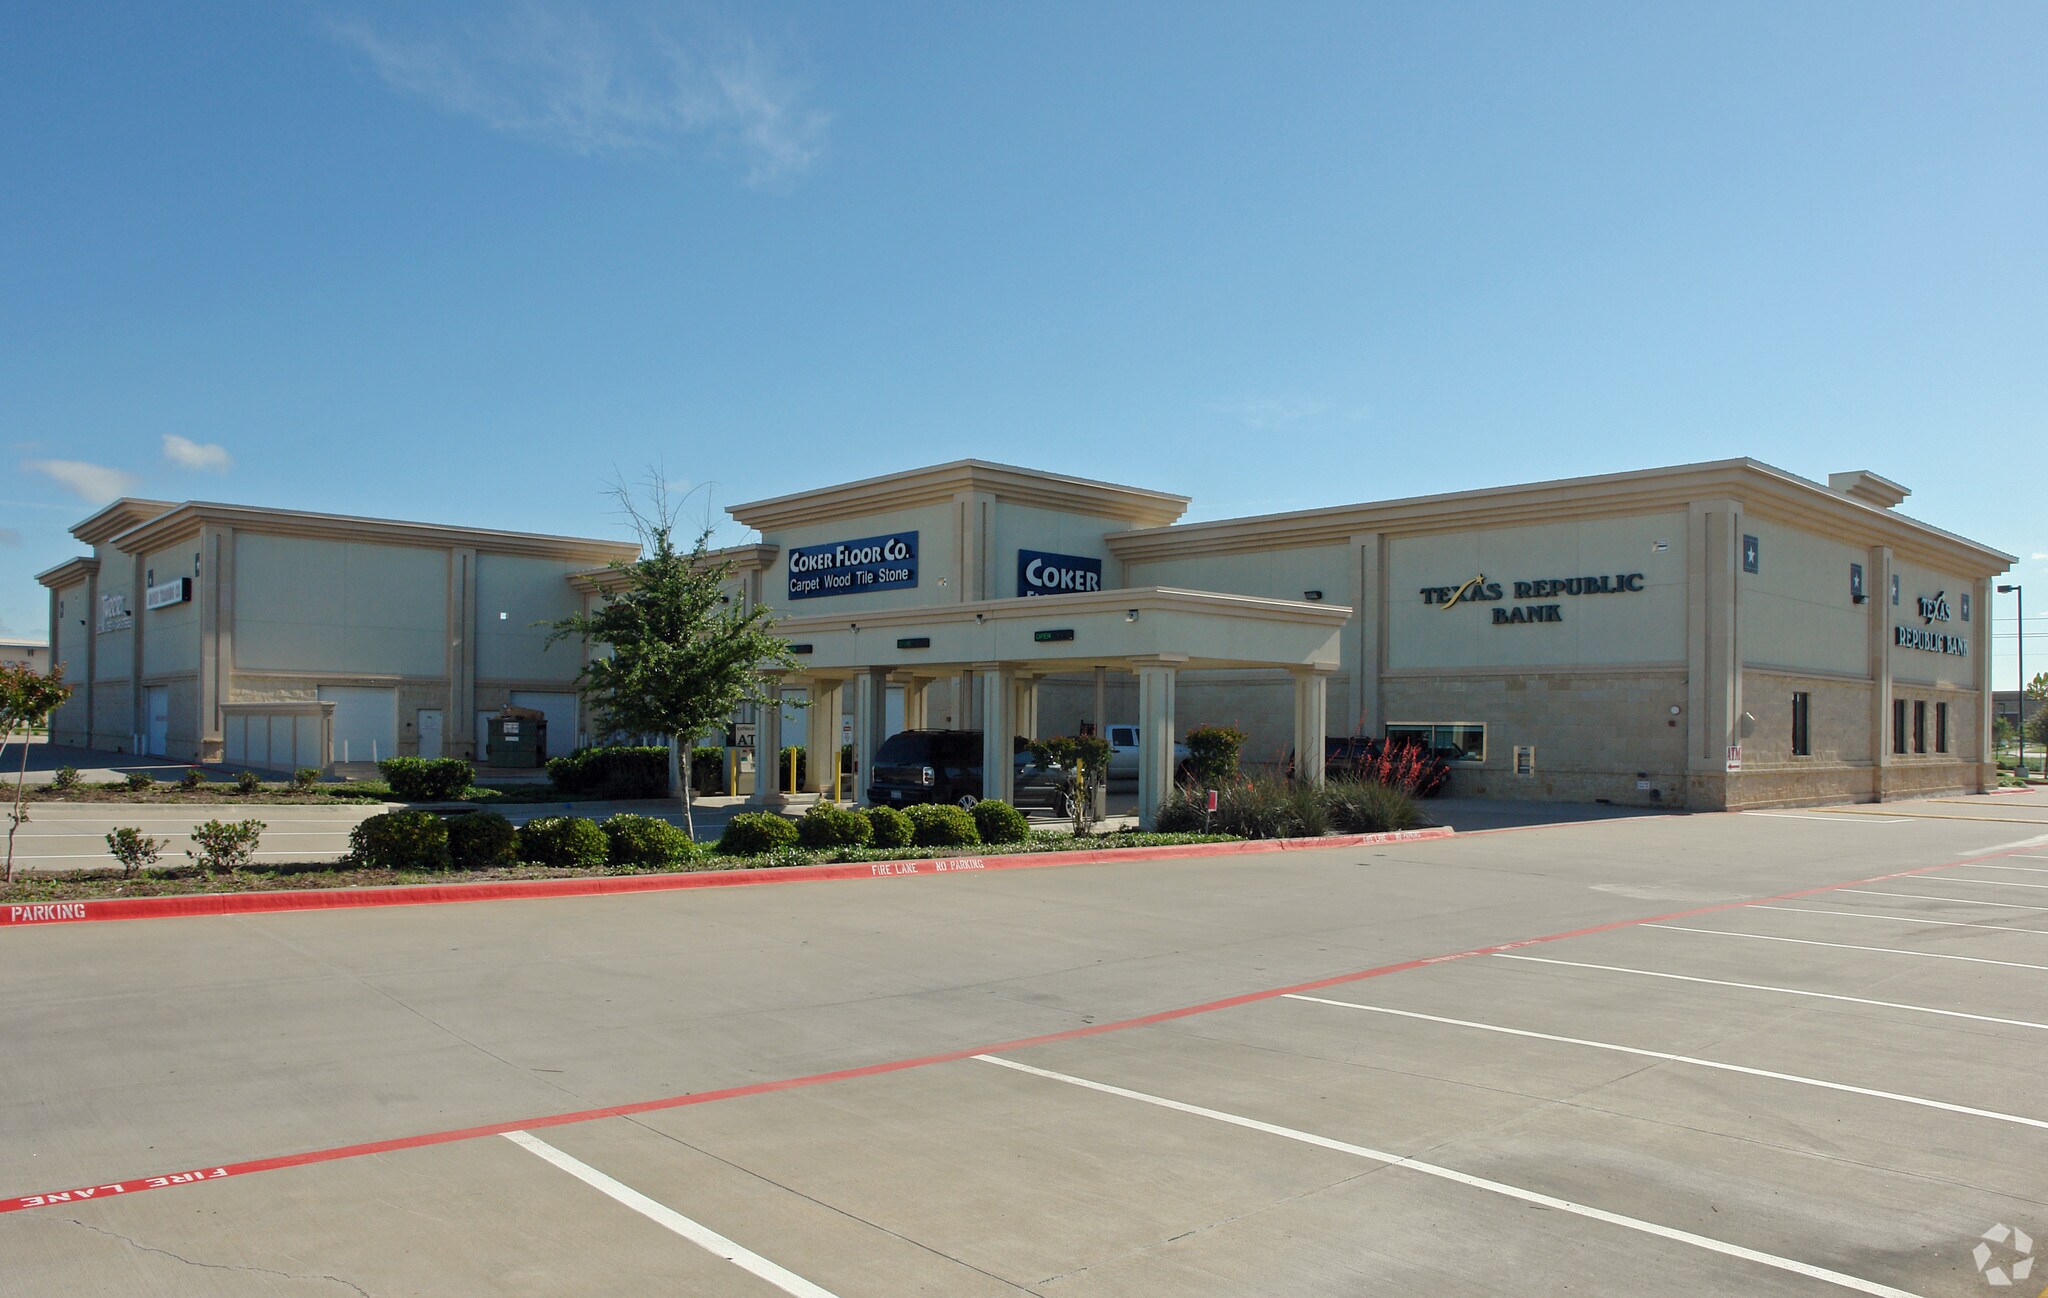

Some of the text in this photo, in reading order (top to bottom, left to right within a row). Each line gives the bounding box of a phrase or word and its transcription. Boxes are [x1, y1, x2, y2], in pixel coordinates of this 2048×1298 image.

[790, 538, 909, 572] COKER FLOOR CO.
[790, 568, 908, 594] Carpet Wood Tile Stone
[1026, 558, 1099, 591] COKER
[1420, 573, 1644, 610] TEXAS REPUBLIC
[1492, 604, 1562, 625] BANK
[1918, 595, 1951, 624] TEXAS
[1896, 627, 1968, 656] REPUBLIC BANK
[738, 734, 755, 745] AT
[1727, 747, 1741, 760] ATM
[872, 859, 984, 875] FIRE LANE NO PARKING
[11, 903, 86, 921] PARKING
[21, 1167, 229, 1208] FIRE LANE
